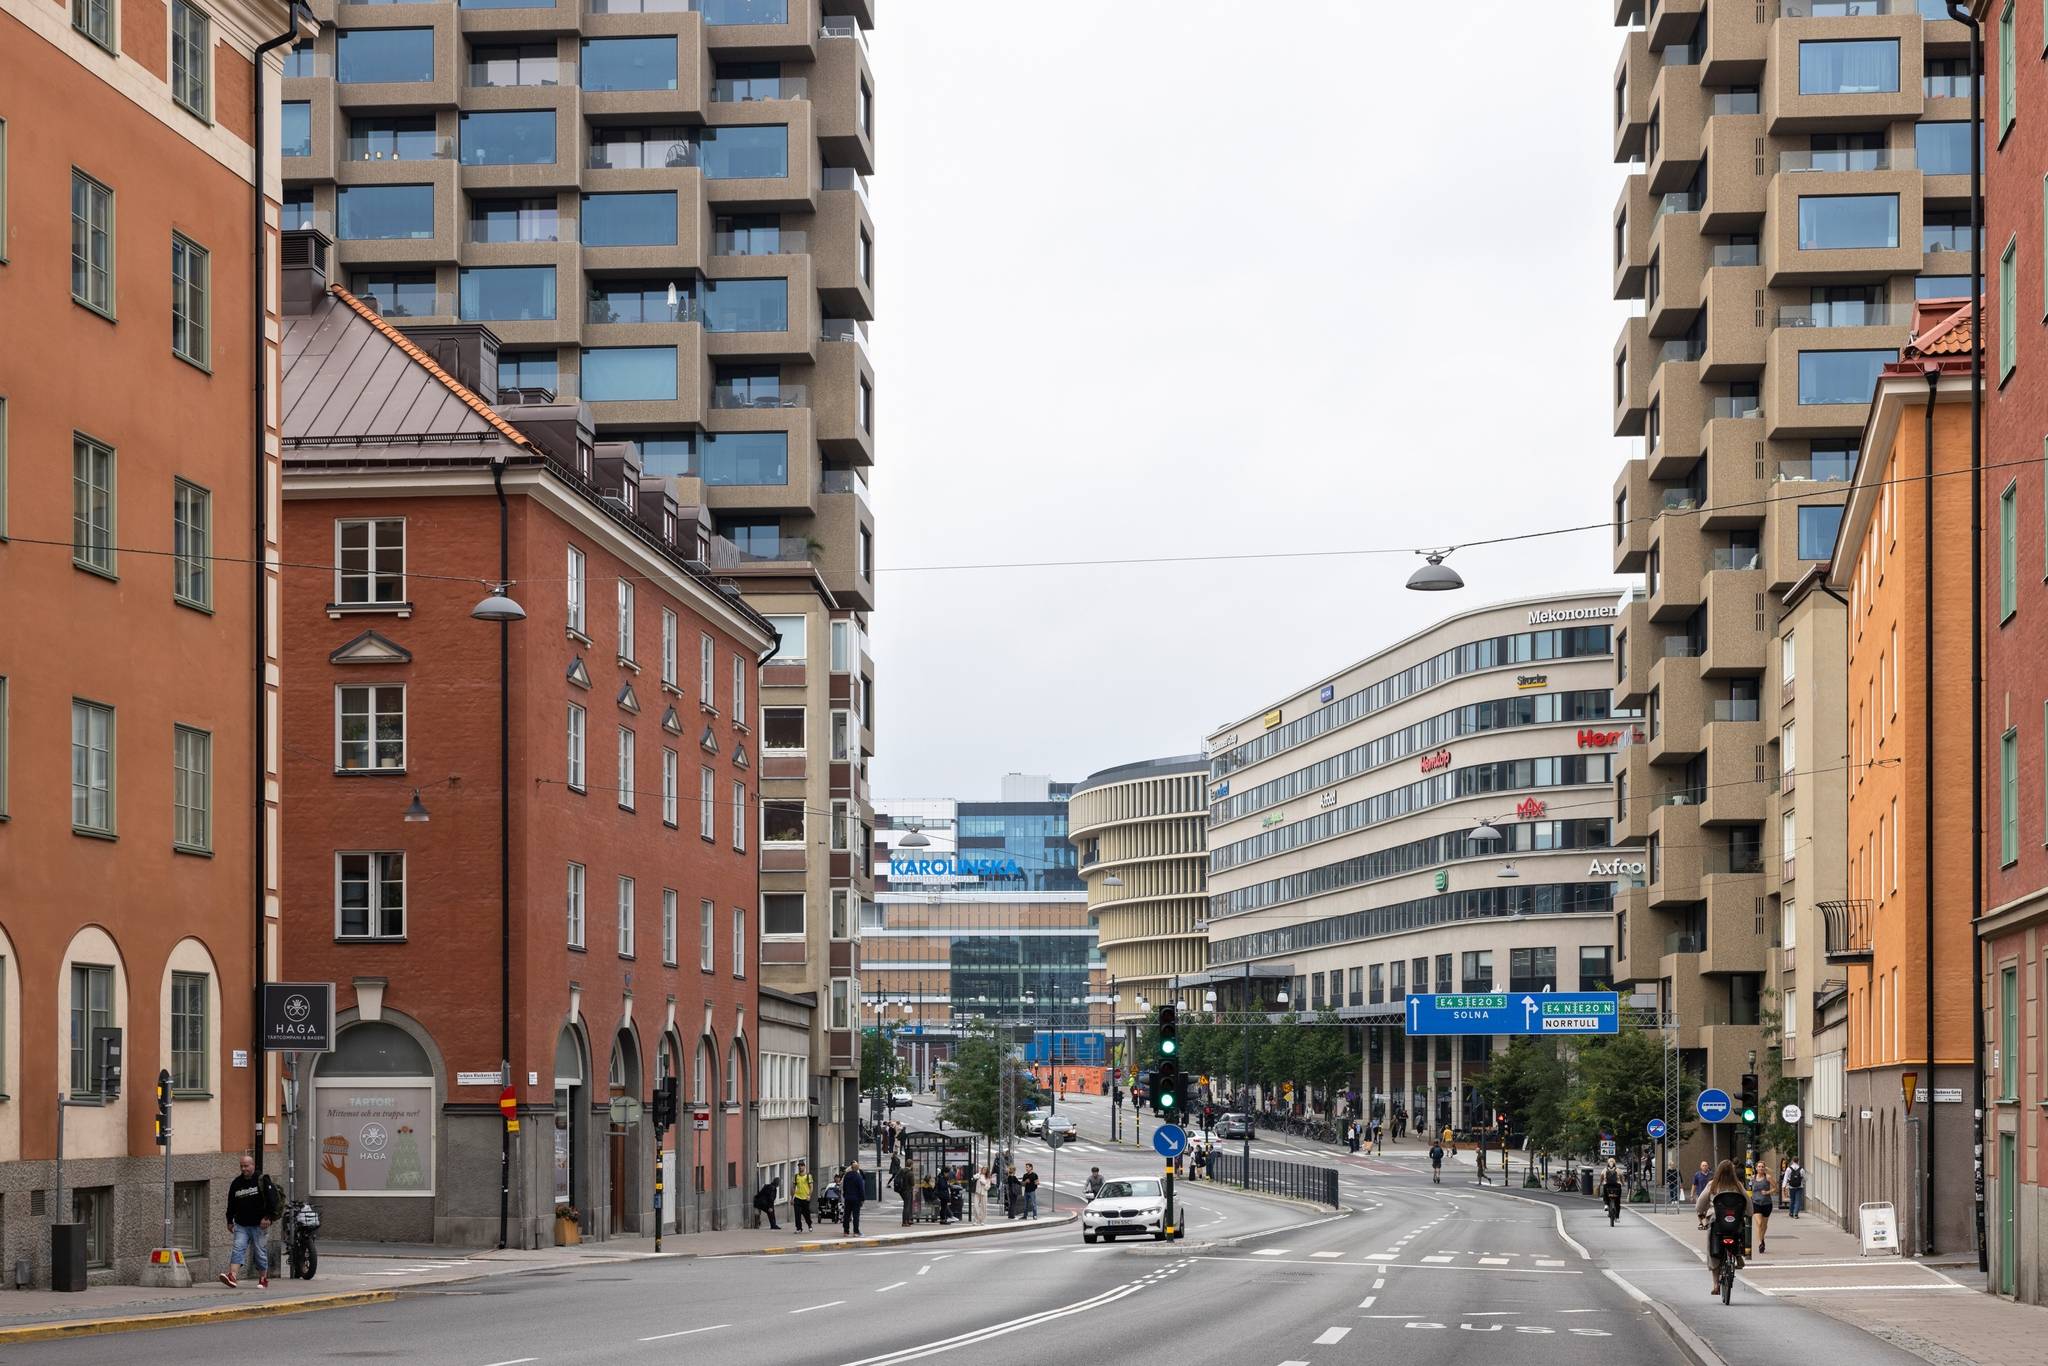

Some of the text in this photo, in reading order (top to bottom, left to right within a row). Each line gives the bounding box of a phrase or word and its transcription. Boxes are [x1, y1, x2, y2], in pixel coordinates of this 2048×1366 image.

[1528, 606, 1618, 625] Mekonomen
[890, 859, 1021, 876] KAROLINSKA
[1440, 999, 1453, 1007] E4
[1497, 998, 1503, 1006] S
[1547, 1003, 1611, 1012] E4 N E20 N
[1453, 1011, 1489, 1019] SOLNA
[1545, 1019, 1596, 1028] NORRTULL
[276, 1024, 316, 1034] HAGA
[361, 1109, 372, 1118] och
